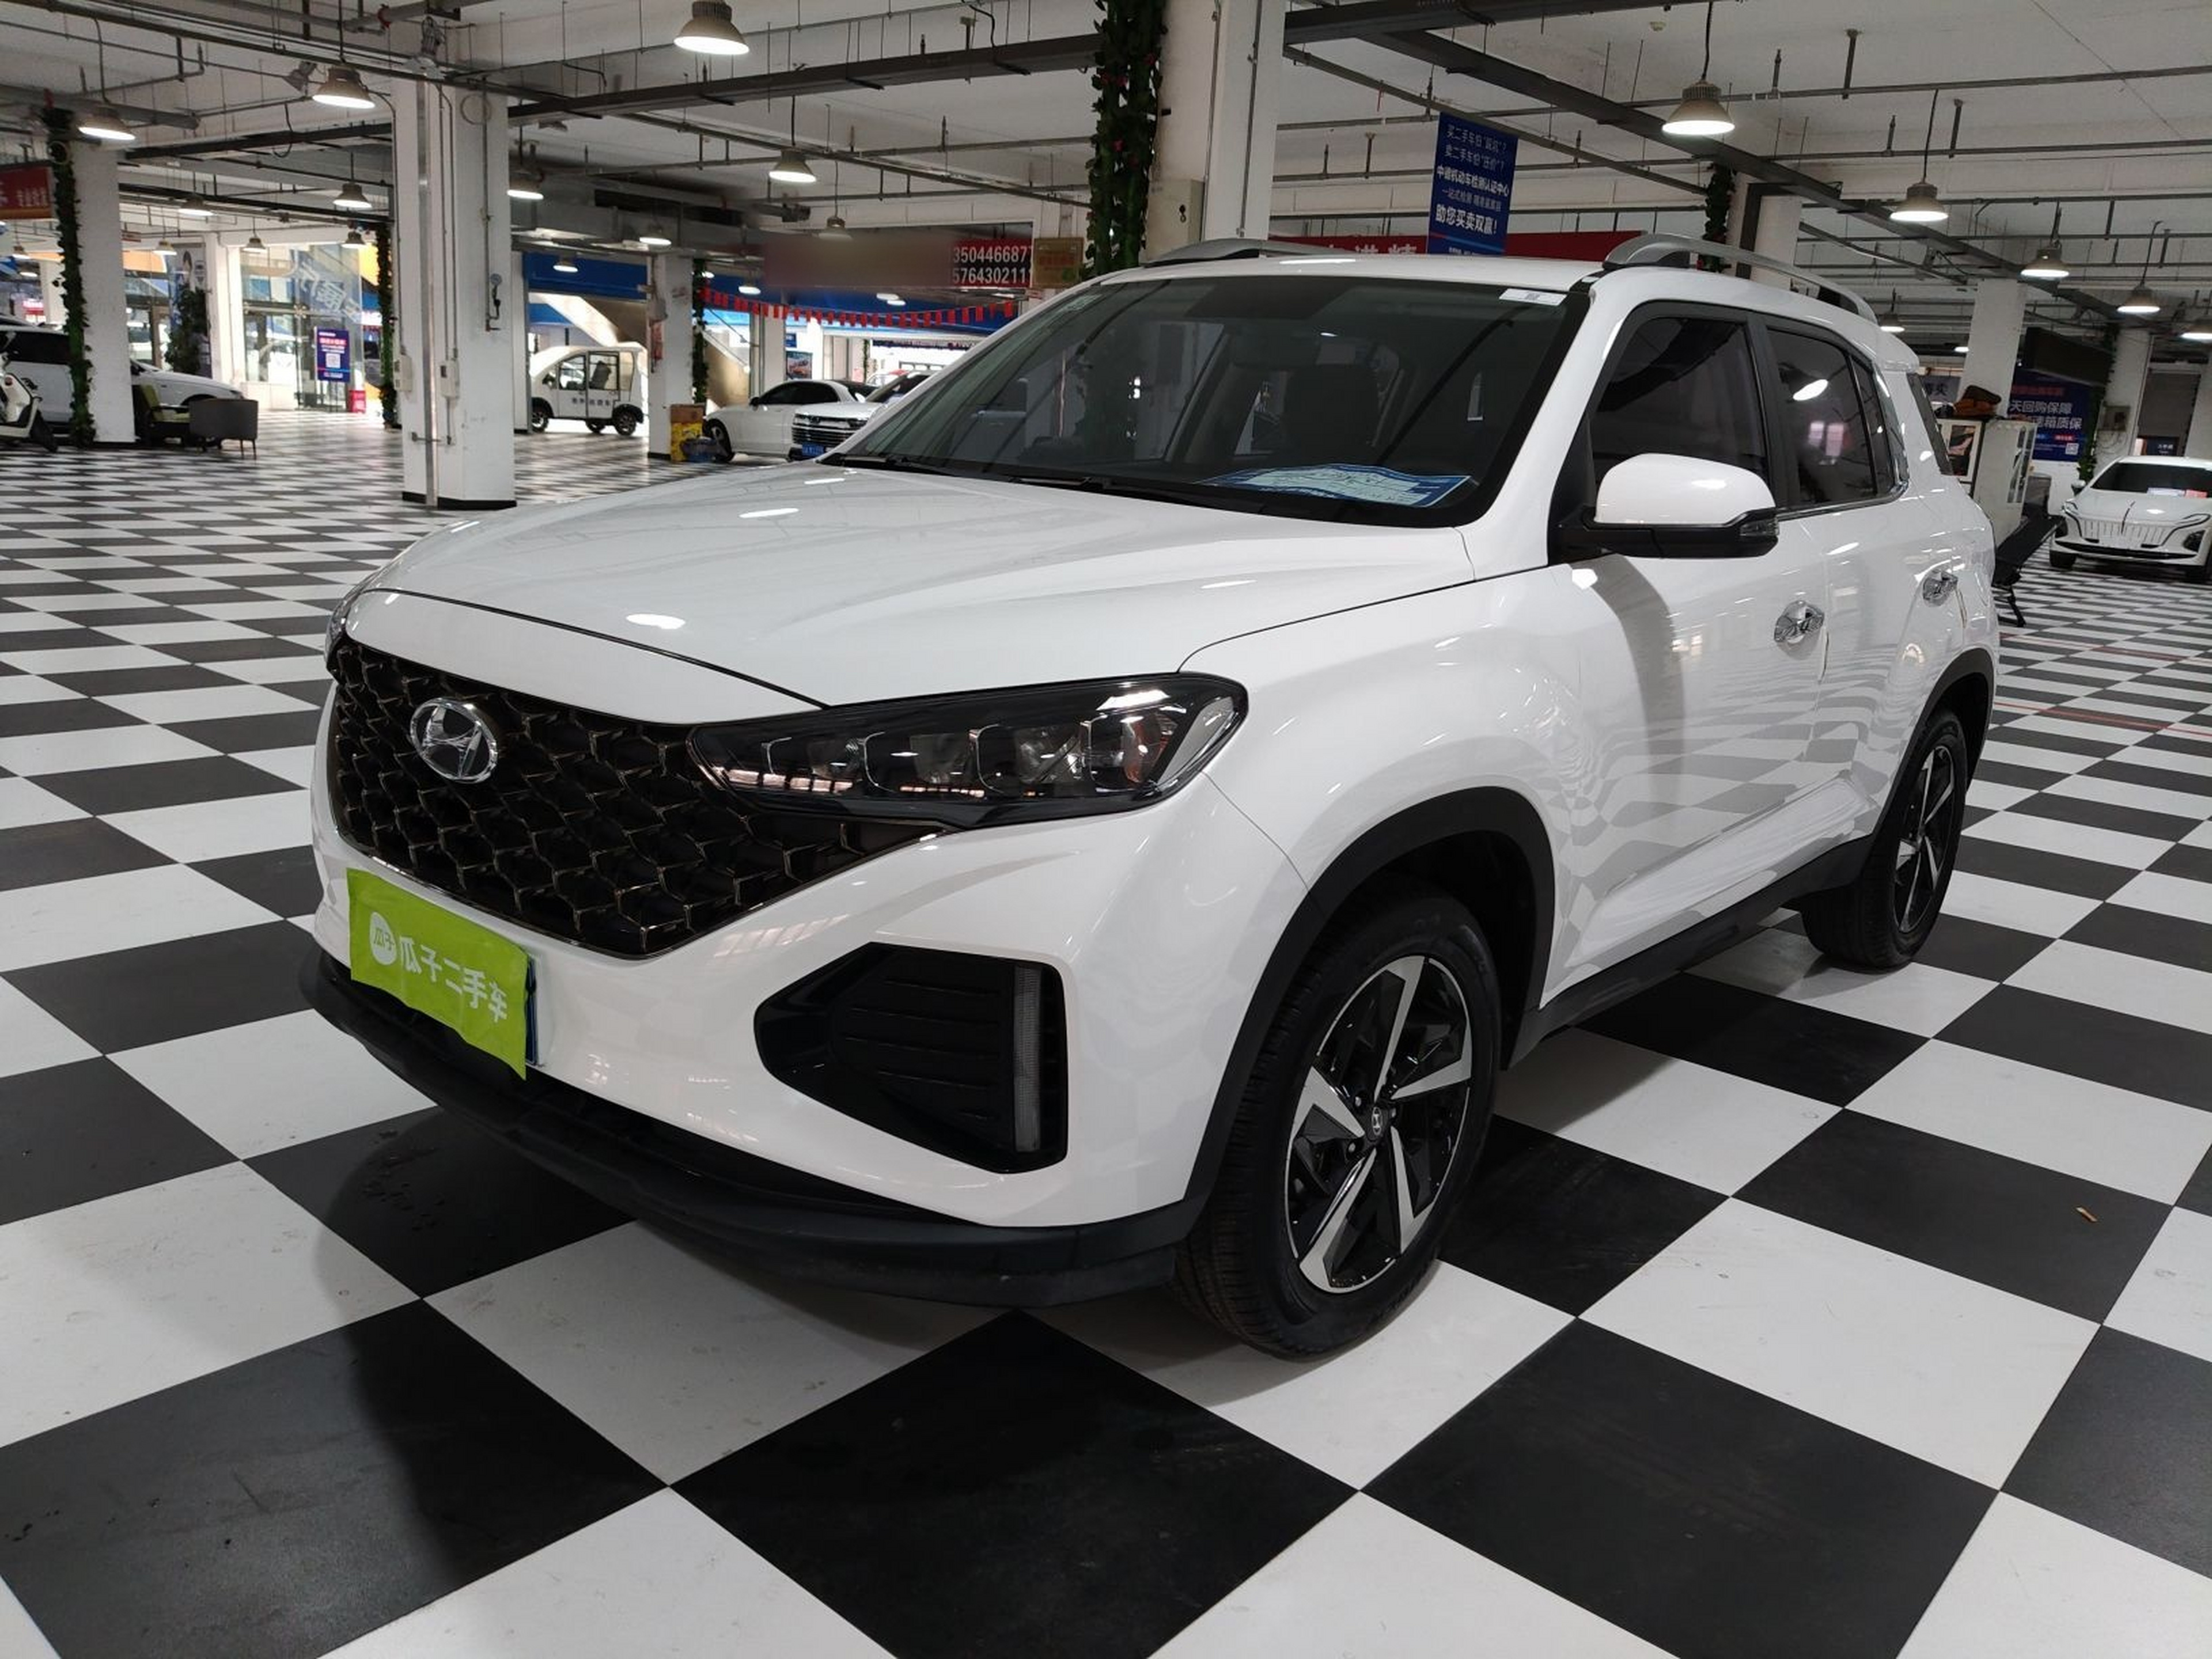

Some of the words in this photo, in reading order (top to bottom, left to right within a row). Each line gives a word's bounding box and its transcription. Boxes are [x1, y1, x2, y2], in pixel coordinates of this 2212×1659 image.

[952, 267, 1032, 283] 576430211
[400, 935, 507, 1023] 瓜子二手车
